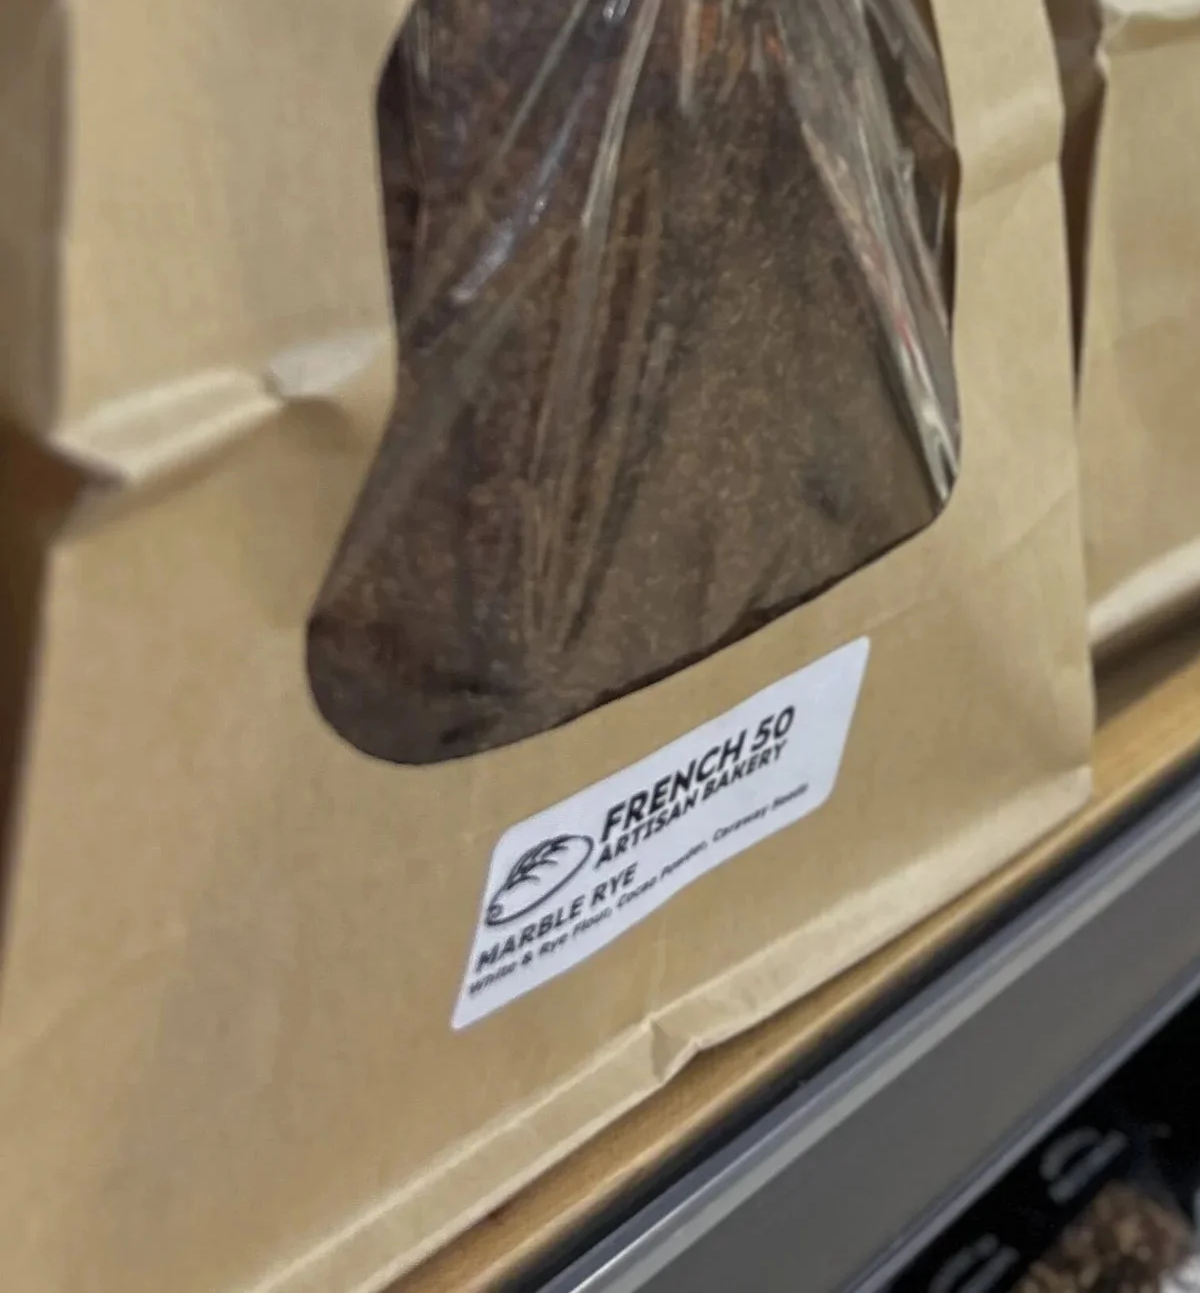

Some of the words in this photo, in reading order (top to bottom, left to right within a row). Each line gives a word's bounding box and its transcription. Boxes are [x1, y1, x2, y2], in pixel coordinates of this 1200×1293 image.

[594, 788, 699, 869] ARTISAN
[701, 738, 787, 801] BAKERY
[600, 728, 748, 843] FRENCH
[751, 705, 795, 753] 50
[475, 894, 586, 974] MARBLE
[591, 861, 638, 907] RYE
[521, 951, 533, 965] &
[540, 933, 568, 956] Rye
